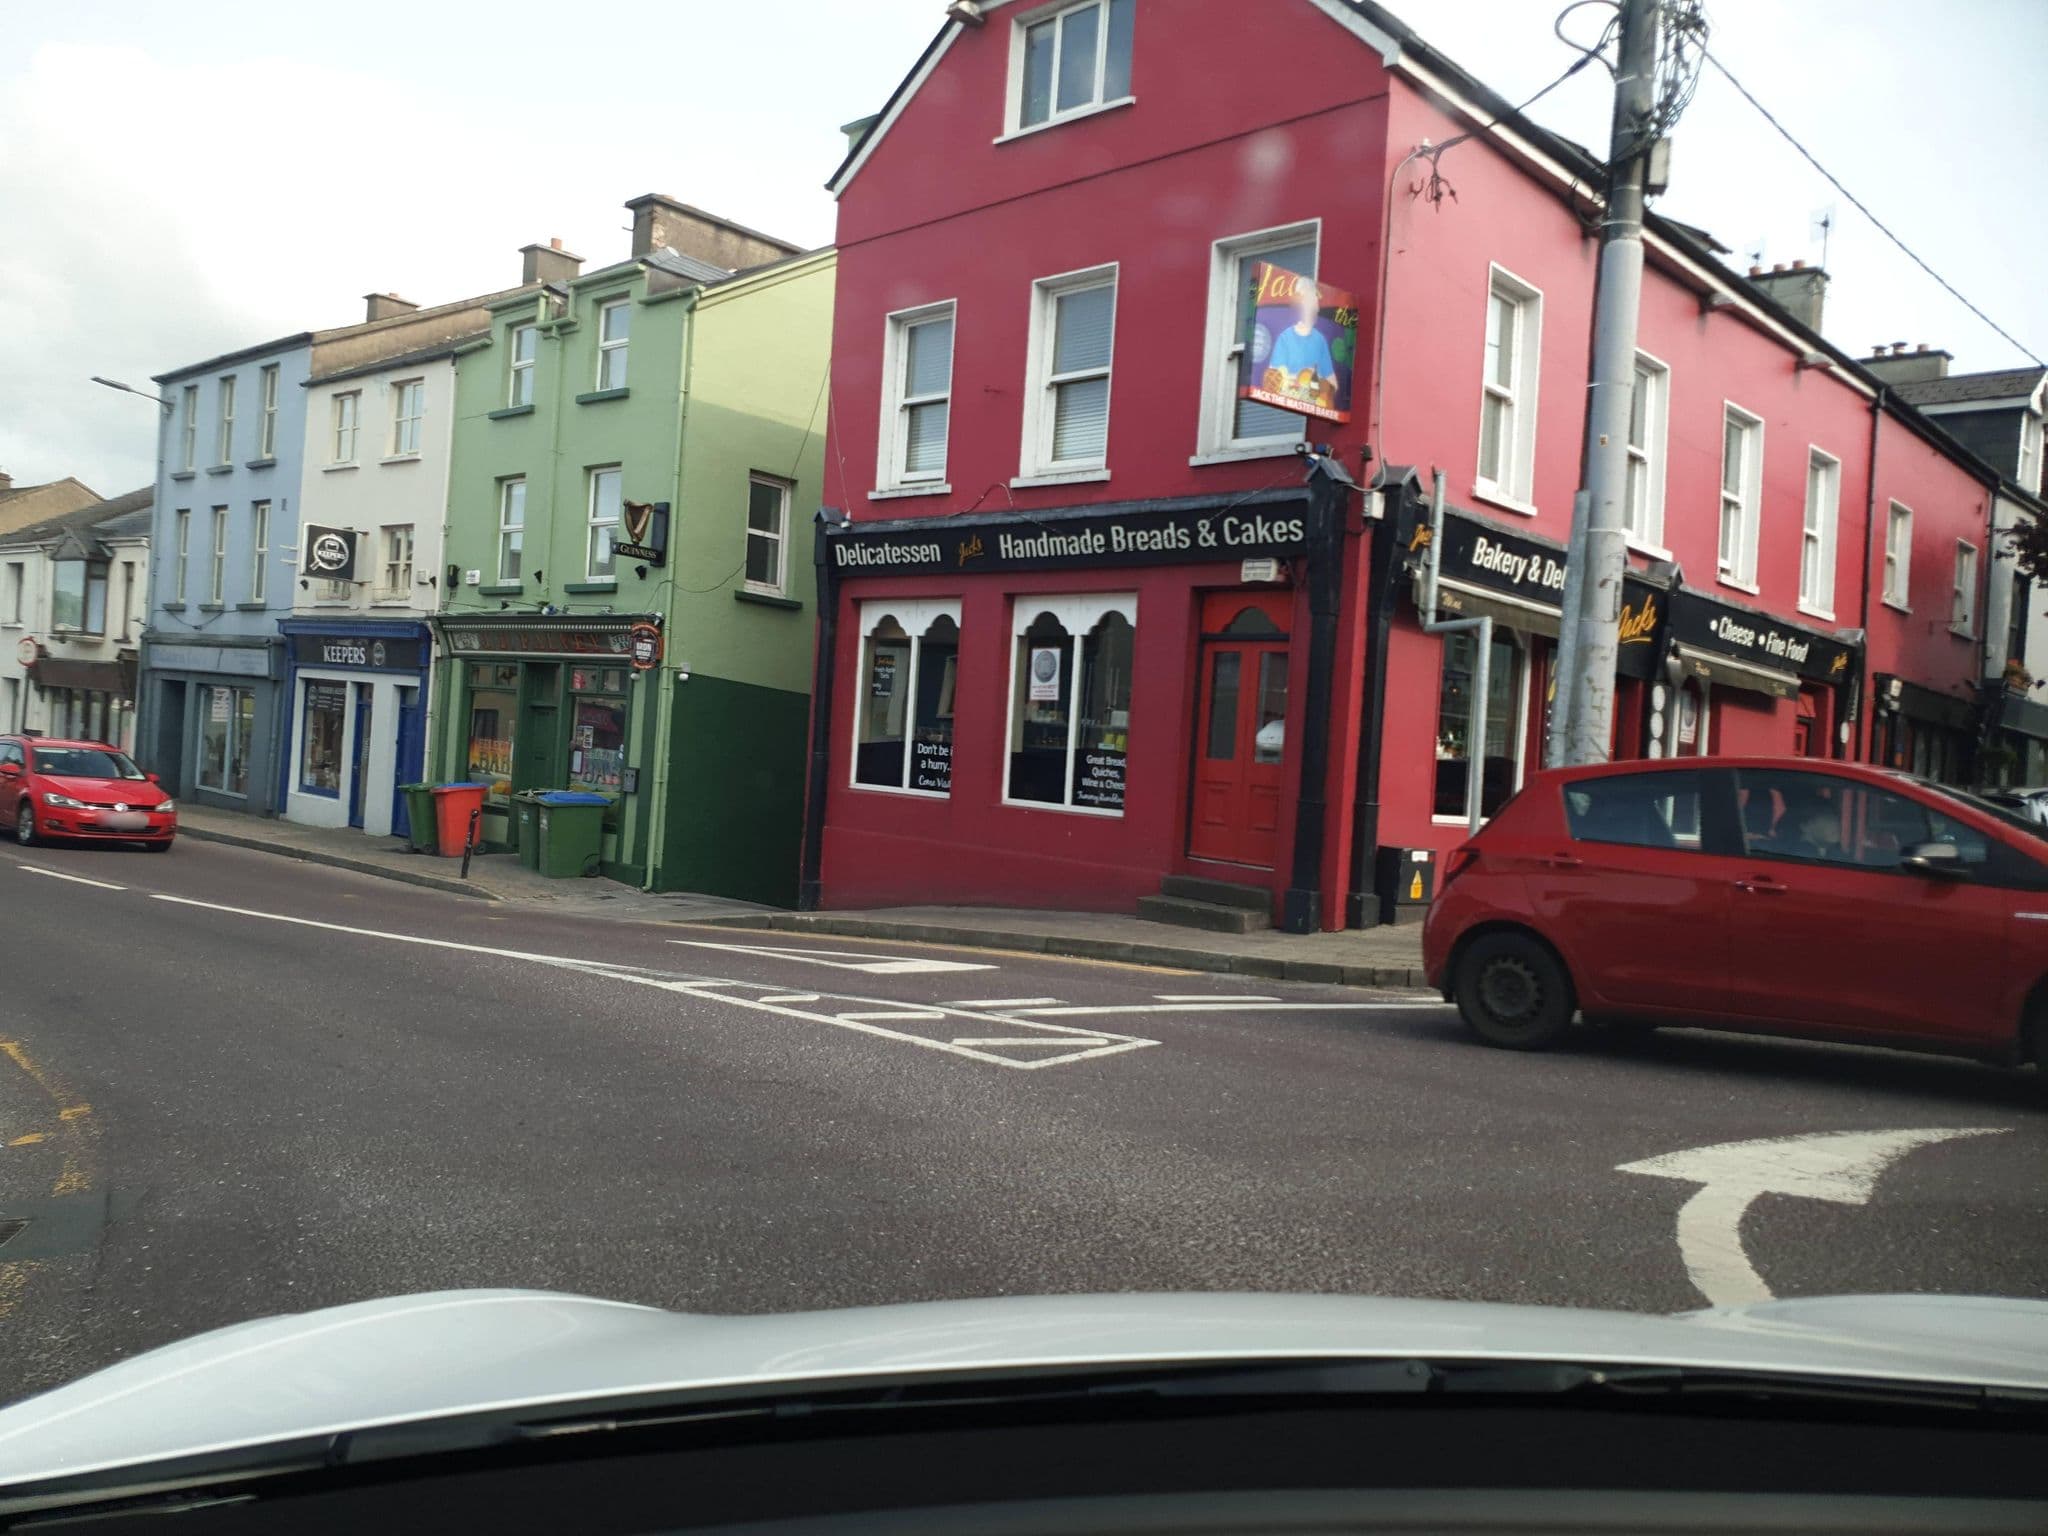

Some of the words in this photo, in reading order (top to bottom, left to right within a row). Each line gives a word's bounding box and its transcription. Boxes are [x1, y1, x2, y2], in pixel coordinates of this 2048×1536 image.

[1285, 399, 1315, 414] MASTER
[1315, 408, 1339, 421] BAKER
[835, 543, 942, 567] Delicatessen
[999, 529, 1105, 559] Handmade
[1110, 521, 1191, 552] Breads
[1197, 518, 1218, 548] &
[1223, 514, 1304, 546] Cakes
[318, 550, 346, 560] KEEPERS
[620, 544, 657, 559] GUINNESS
[1471, 536, 1528, 584] Bakery
[1527, 554, 1541, 583] &
[1542, 558, 1568, 590] Del
[1616, 593, 1657, 643] Jacks
[1718, 616, 1755, 648] Cheese
[1765, 631, 1786, 656] Fine
[1785, 637, 1810, 663] Food
[323, 645, 366, 664] KEEPERS
[917, 743, 937, 755] Don't
[938, 745, 949, 756] be
[920, 760, 927, 769] a
[1086, 754, 1104, 765] Great
[1081, 777, 1099, 788] Wine
